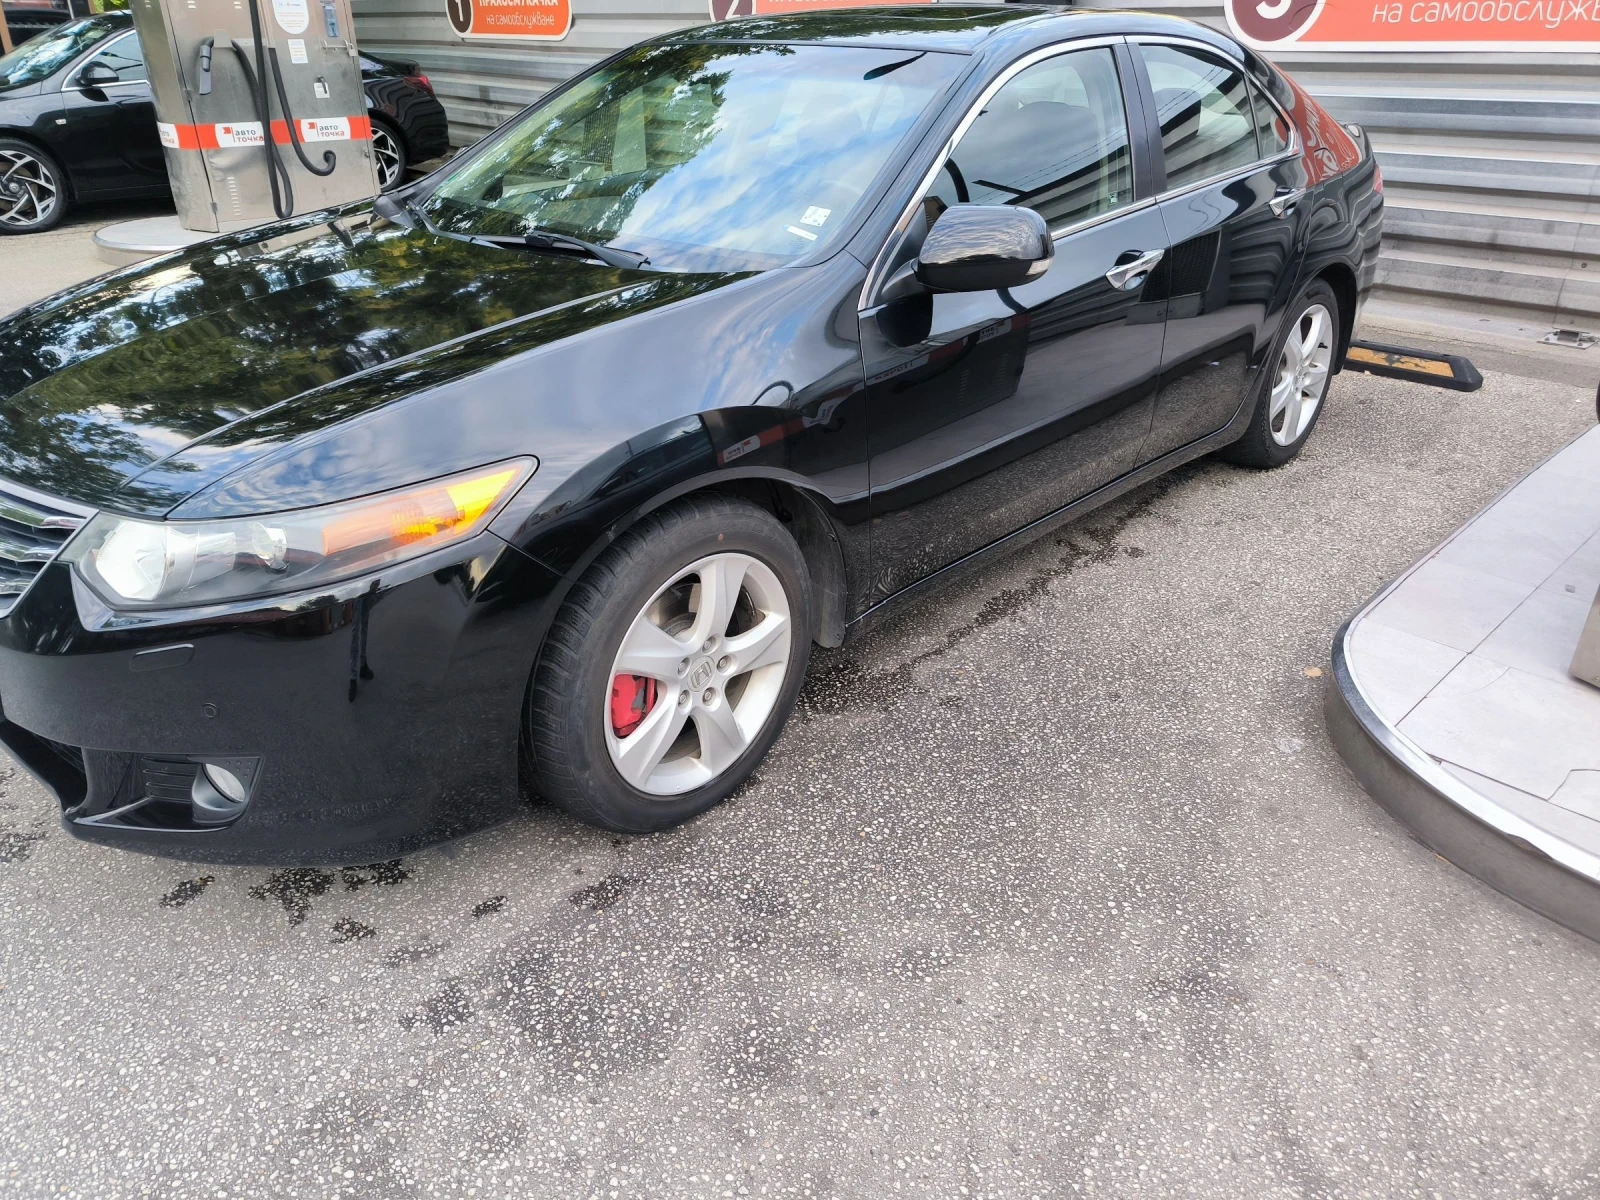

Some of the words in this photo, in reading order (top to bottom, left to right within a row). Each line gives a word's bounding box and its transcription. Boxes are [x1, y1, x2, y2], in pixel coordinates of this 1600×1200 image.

[1372, 2, 1403, 23] на
[486, 15, 495, 25] на
[496, 12, 555, 28] самообслужване
[319, 124, 339, 132] авто
[235, 129, 256, 137] авто
[320, 130, 345, 138] точка
[237, 135, 264, 143] точка
